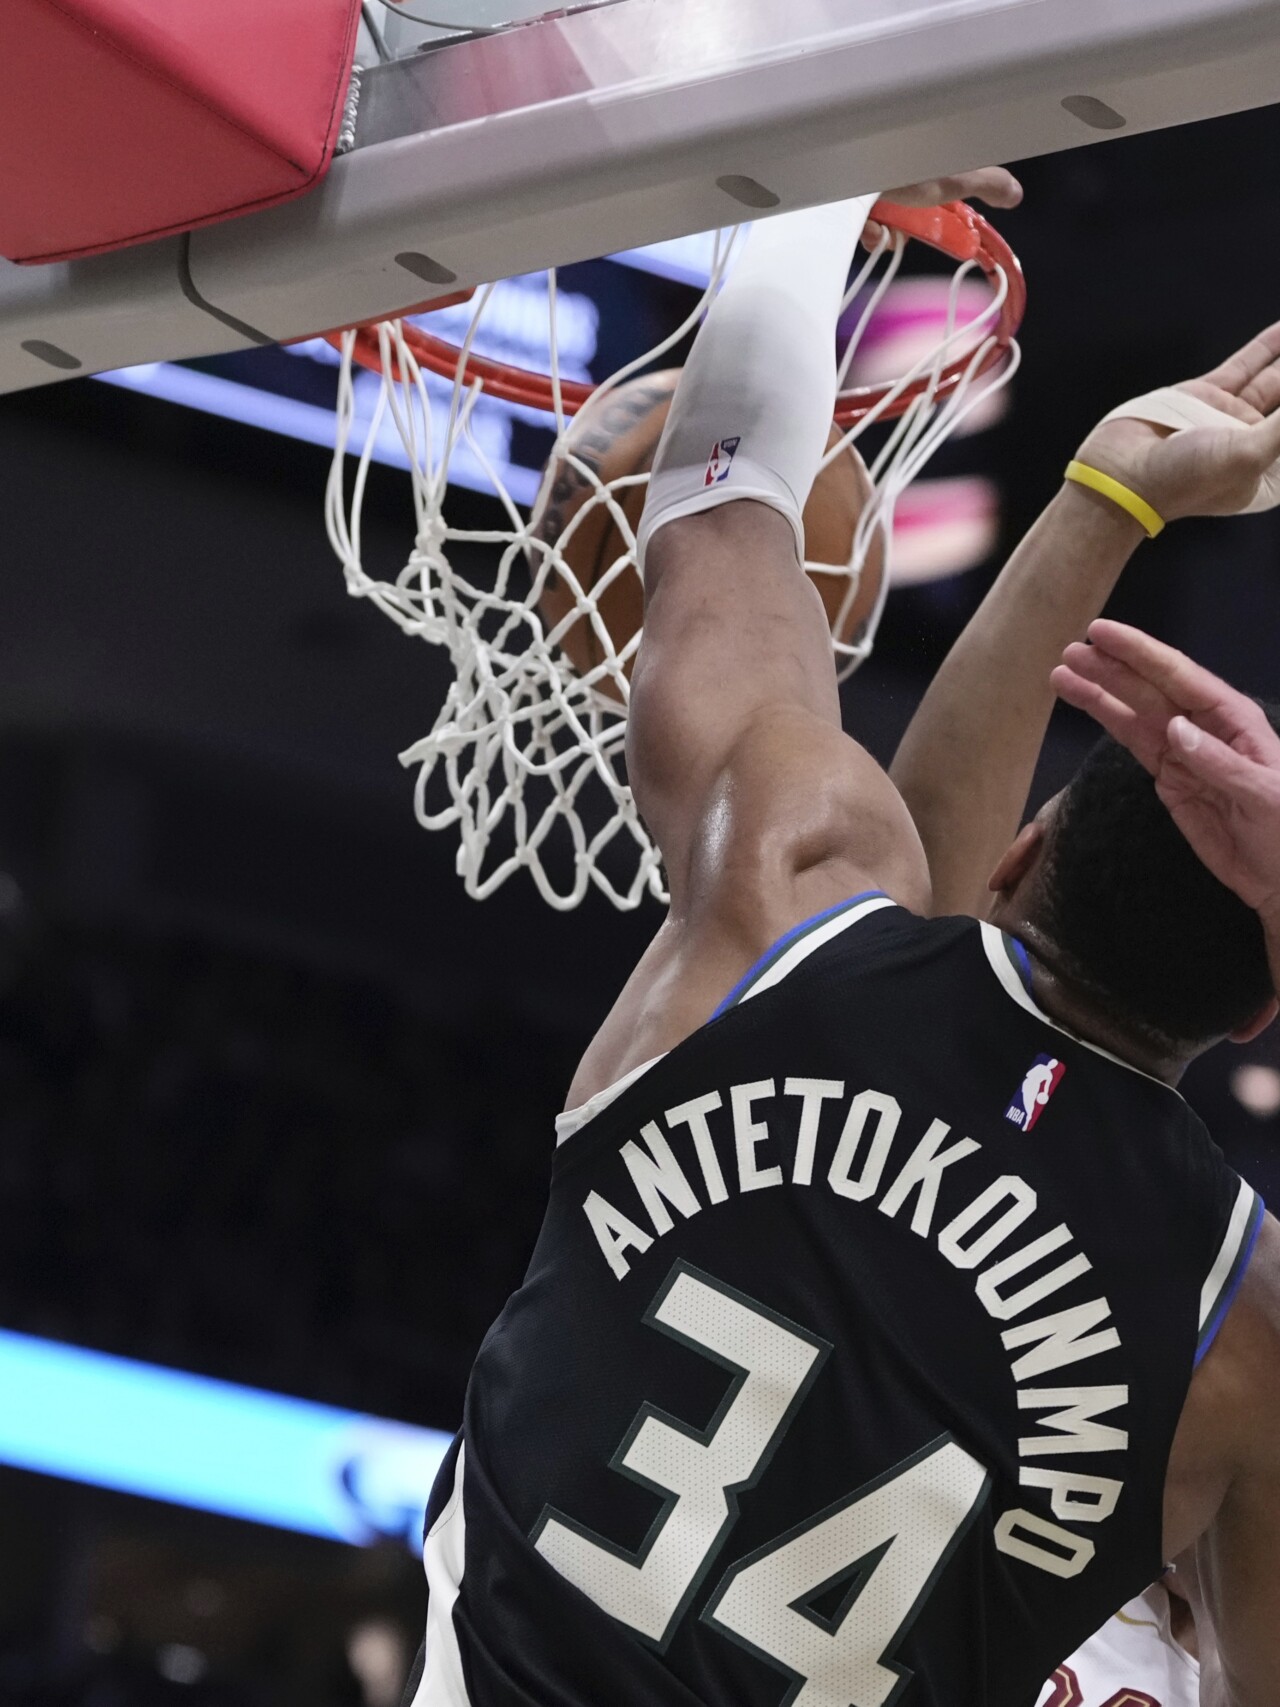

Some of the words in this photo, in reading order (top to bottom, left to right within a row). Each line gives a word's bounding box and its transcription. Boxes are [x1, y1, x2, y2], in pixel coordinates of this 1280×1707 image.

[582, 1076, 1129, 1579] ANTETOKOUNMPO
[1005, 1105, 1026, 1125] NBA
[529, 1260, 991, 1707] 34
